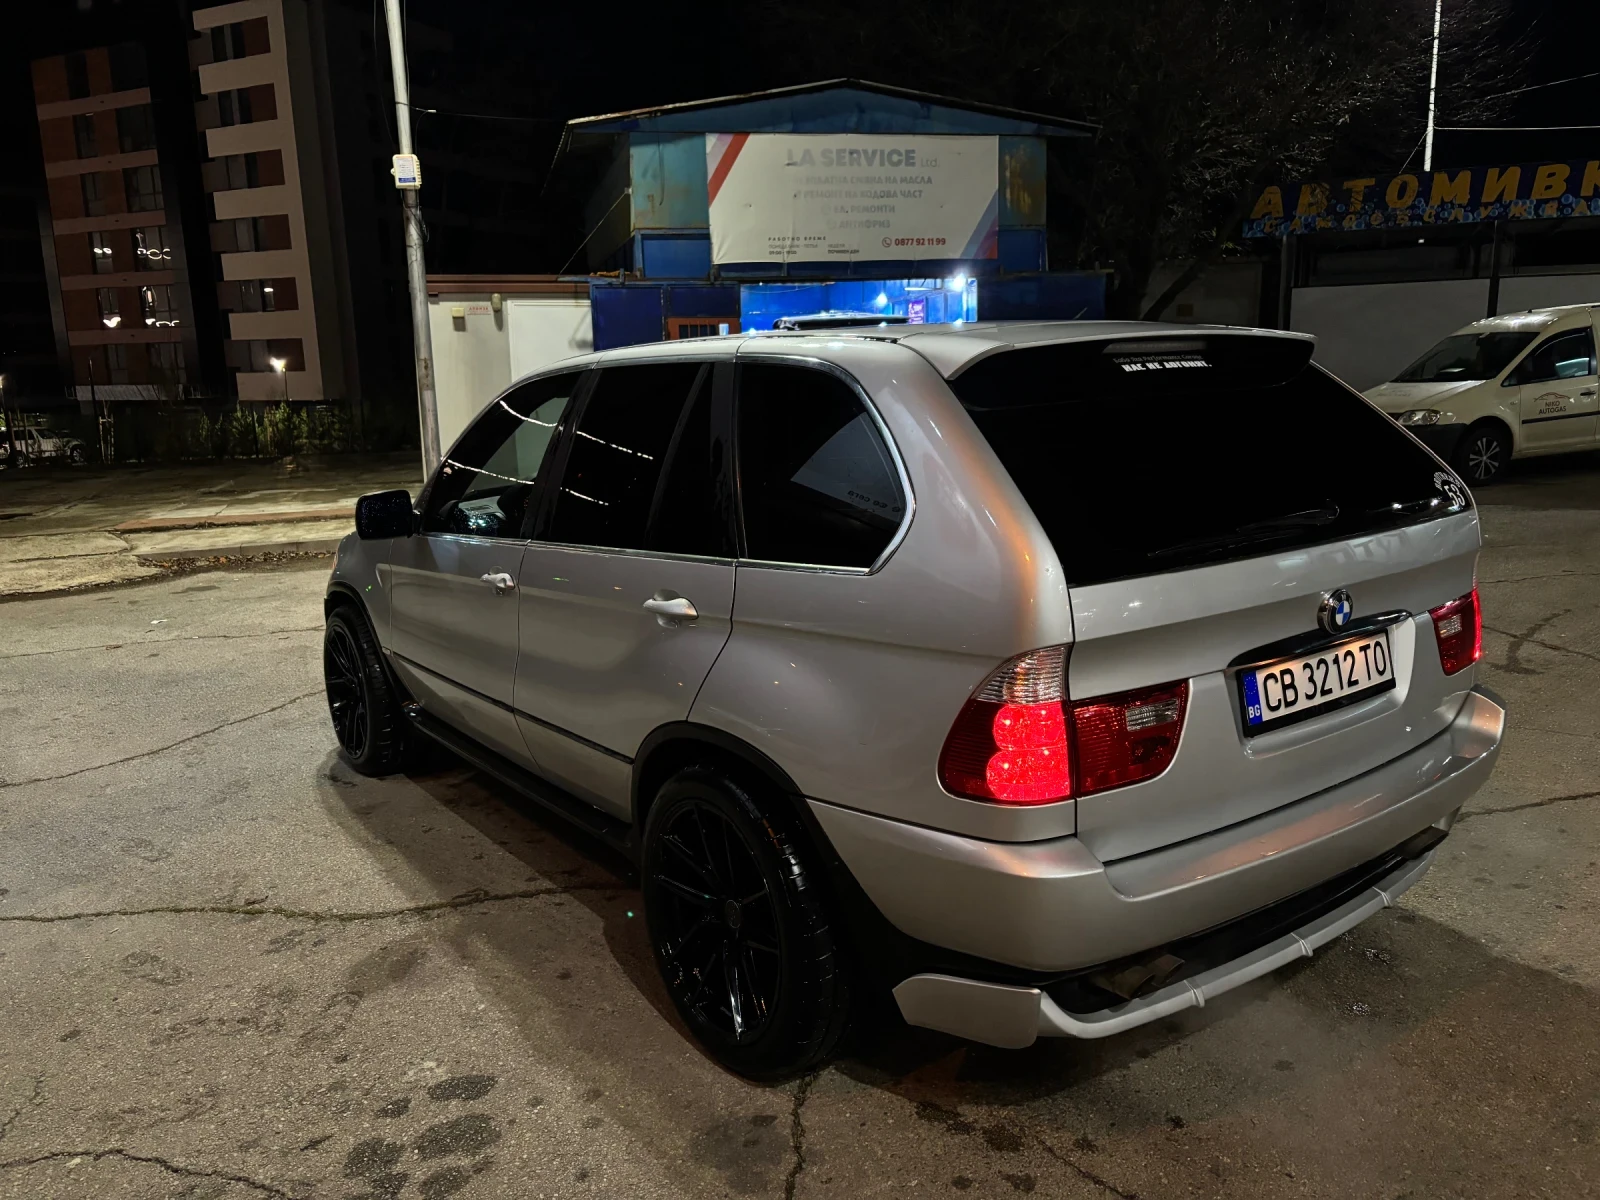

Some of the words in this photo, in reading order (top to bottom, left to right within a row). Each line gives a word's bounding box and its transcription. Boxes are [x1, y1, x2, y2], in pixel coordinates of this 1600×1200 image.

[820, 147, 916, 168] SERVICE
[920, 156, 940, 168] Ltd.
[899, 175, 933, 185] МАСЛА
[899, 190, 923, 199] ЧАСТ
[850, 204, 896, 214] РЕМОНТИ
[838, 219, 891, 230] АНТИФРИЗ
[894, 237, 914, 246] 0877
[915, 237, 925, 246] 92
[1545, 400, 1561, 408] NIKO
[1538, 406, 1567, 415] AUTOGAS
[1263, 668, 1299, 712] CB
[1302, 649, 1360, 701] 3212
[1358, 640, 1387, 681] TO
[1248, 704, 1261, 718] BG
